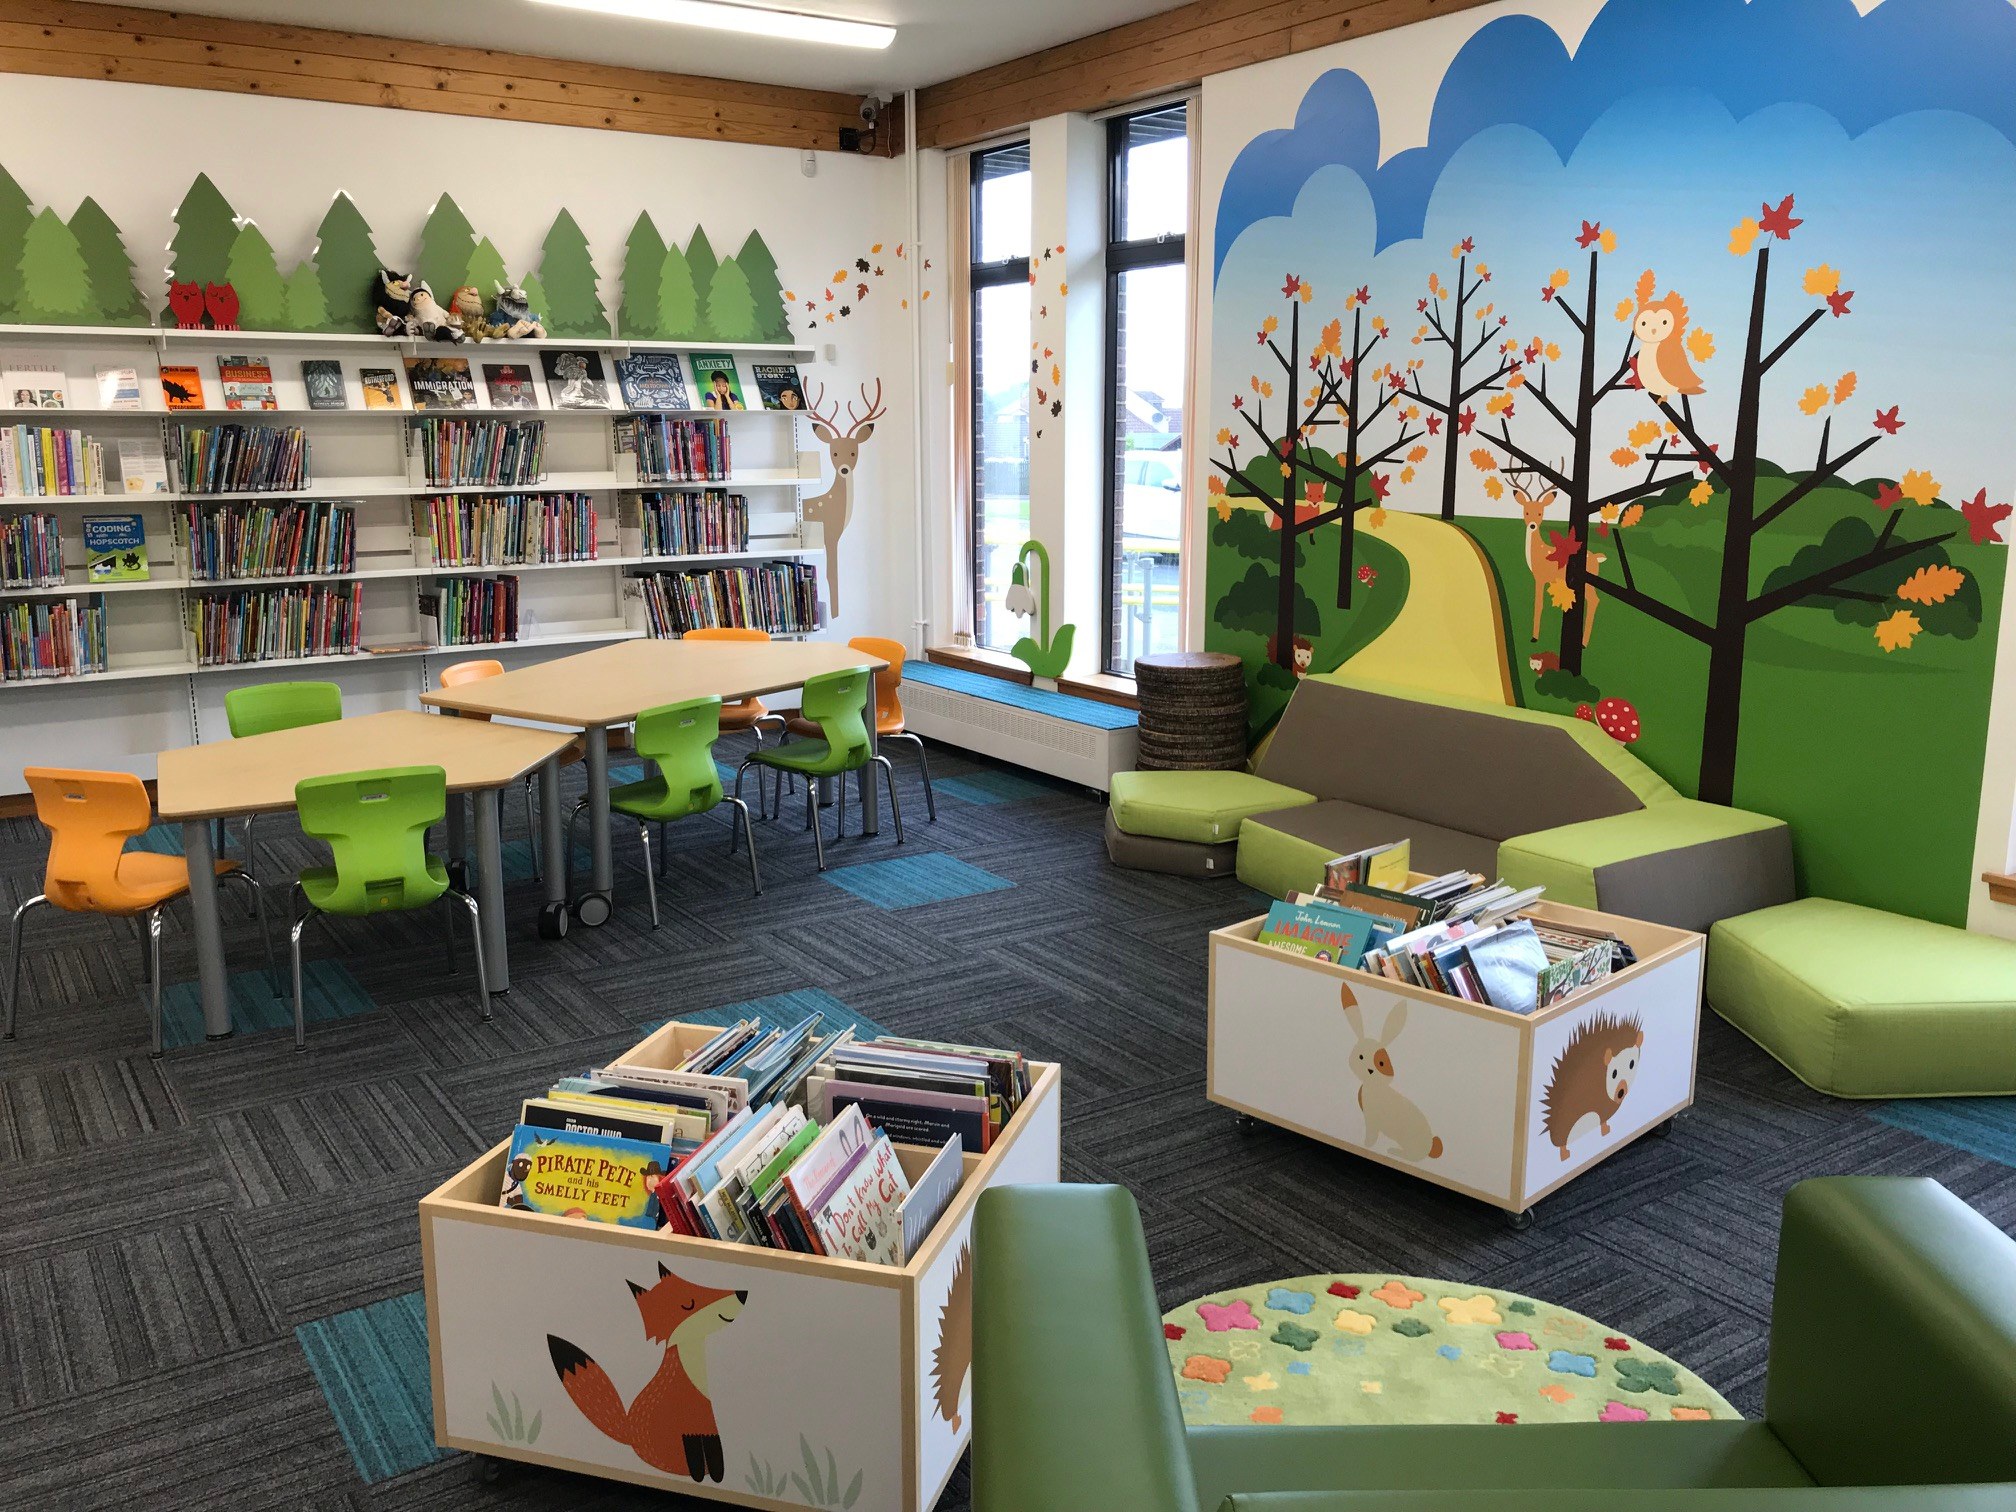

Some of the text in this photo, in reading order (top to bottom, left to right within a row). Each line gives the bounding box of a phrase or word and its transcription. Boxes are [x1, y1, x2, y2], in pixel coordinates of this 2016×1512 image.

[225, 370, 268, 378] BUSINESS
[699, 360, 732, 369] ANXIETY
[414, 381, 474, 391] IMMIGRATION
[92, 525, 131, 533] CODING
[1295, 910, 1341, 929] John Lennon
[1274, 920, 1354, 954] IMAGINE
[537, 1154, 637, 1188] PIRATE PETE
[567, 1177, 599, 1188] and his
[535, 1181, 631, 1208] SMELLY FEET
[824, 1228, 838, 1254] I
[832, 1195, 857, 1238] Don't
[873, 1143, 892, 1178] What
[852, 1210, 867, 1243] Call
[866, 1199, 882, 1217] My
[878, 1170, 899, 1204] Cat
